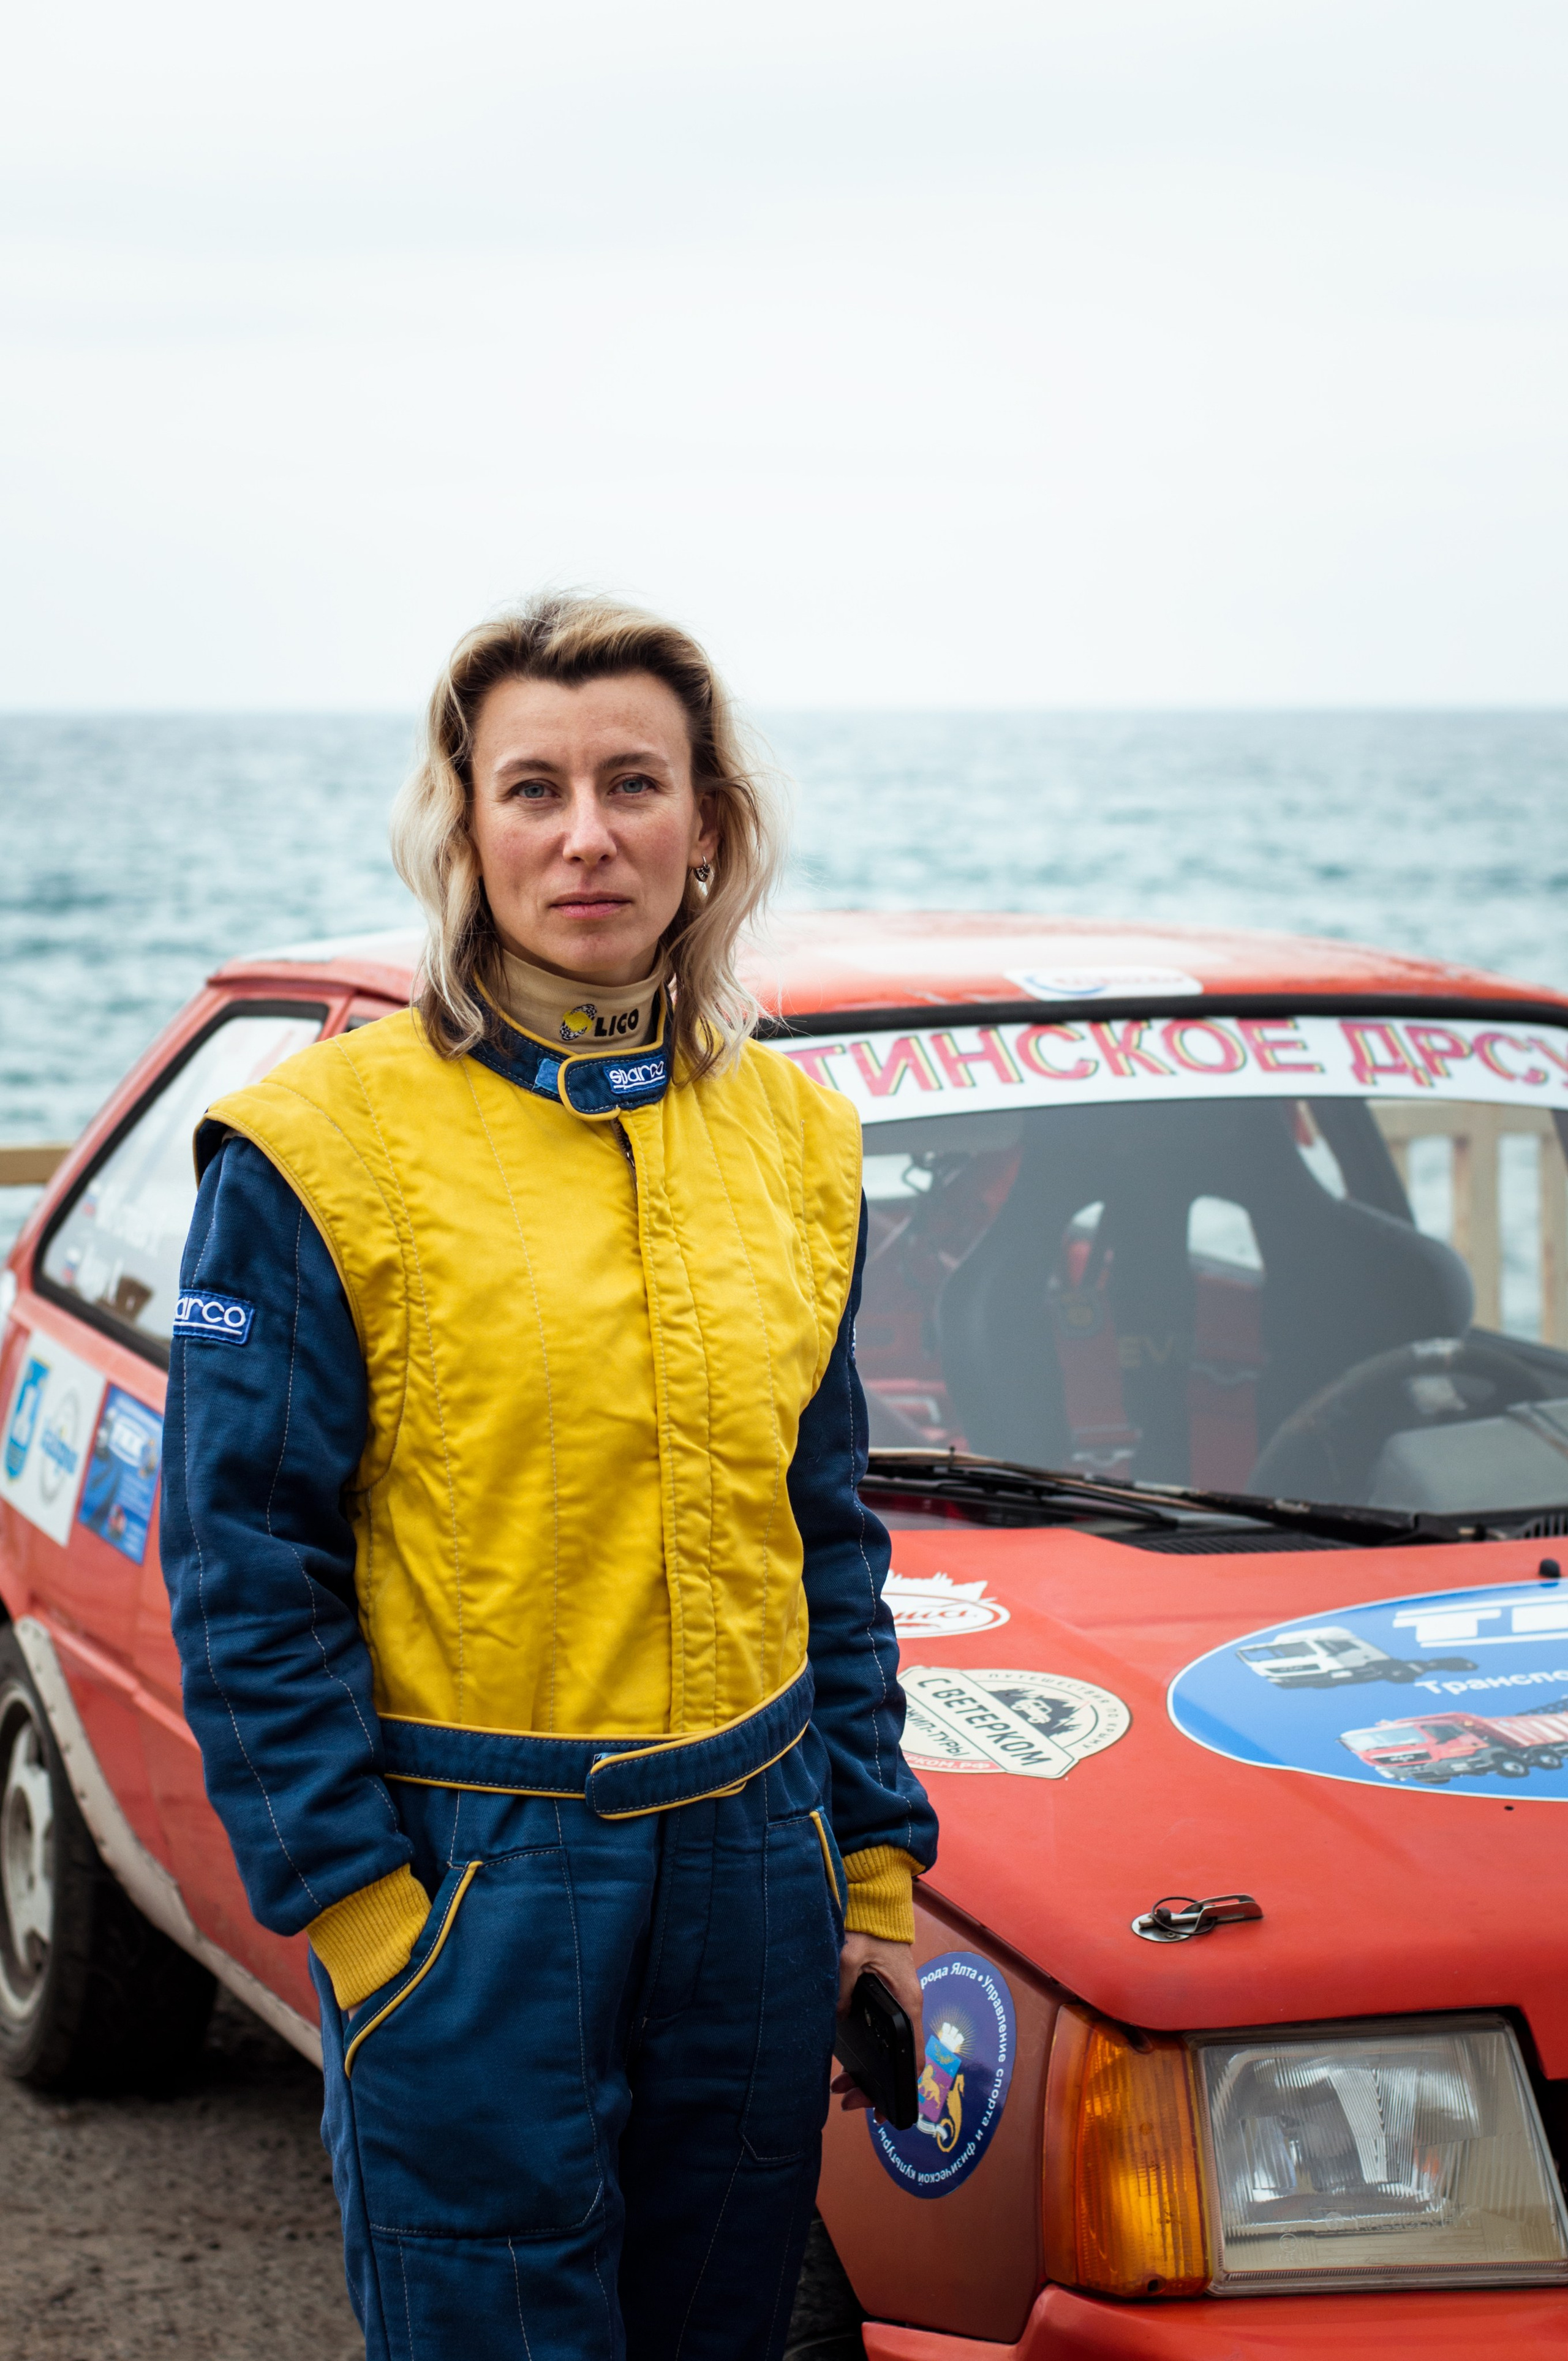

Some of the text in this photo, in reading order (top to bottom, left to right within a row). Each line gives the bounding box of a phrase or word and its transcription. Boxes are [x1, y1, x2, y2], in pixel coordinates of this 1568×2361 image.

[594, 1008, 639, 1036] LICO
[609, 1061, 664, 1090] sparco
[907, 1704, 970, 1757] ЖИП-ТУРЫ
[903, 1754, 990, 1769] РКОМ.РФ
[950, 1962, 978, 1979] Ялта
[878, 1975, 1007, 2186] Управление спорта и физической культуры
